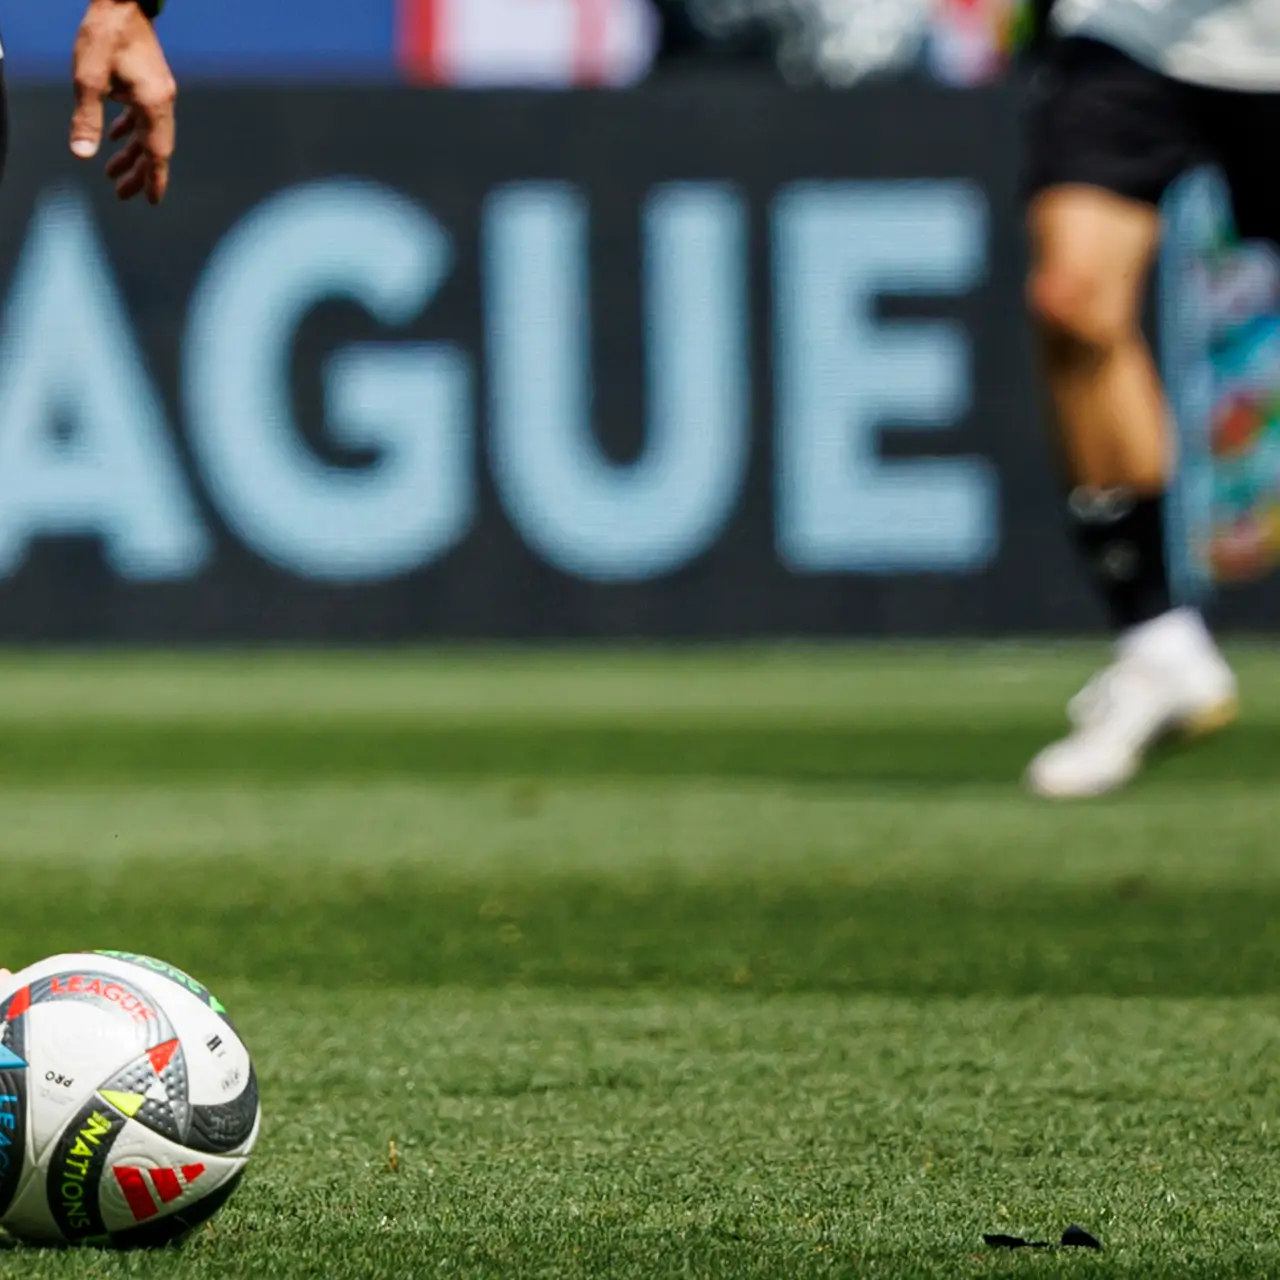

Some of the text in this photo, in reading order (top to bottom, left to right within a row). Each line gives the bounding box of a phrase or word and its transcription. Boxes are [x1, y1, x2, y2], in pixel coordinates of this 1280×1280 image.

[49, 975, 158, 1023] LEAGUE
[45, 1070, 75, 1089] PRO
[61, 1110, 113, 1229] NATIONS
